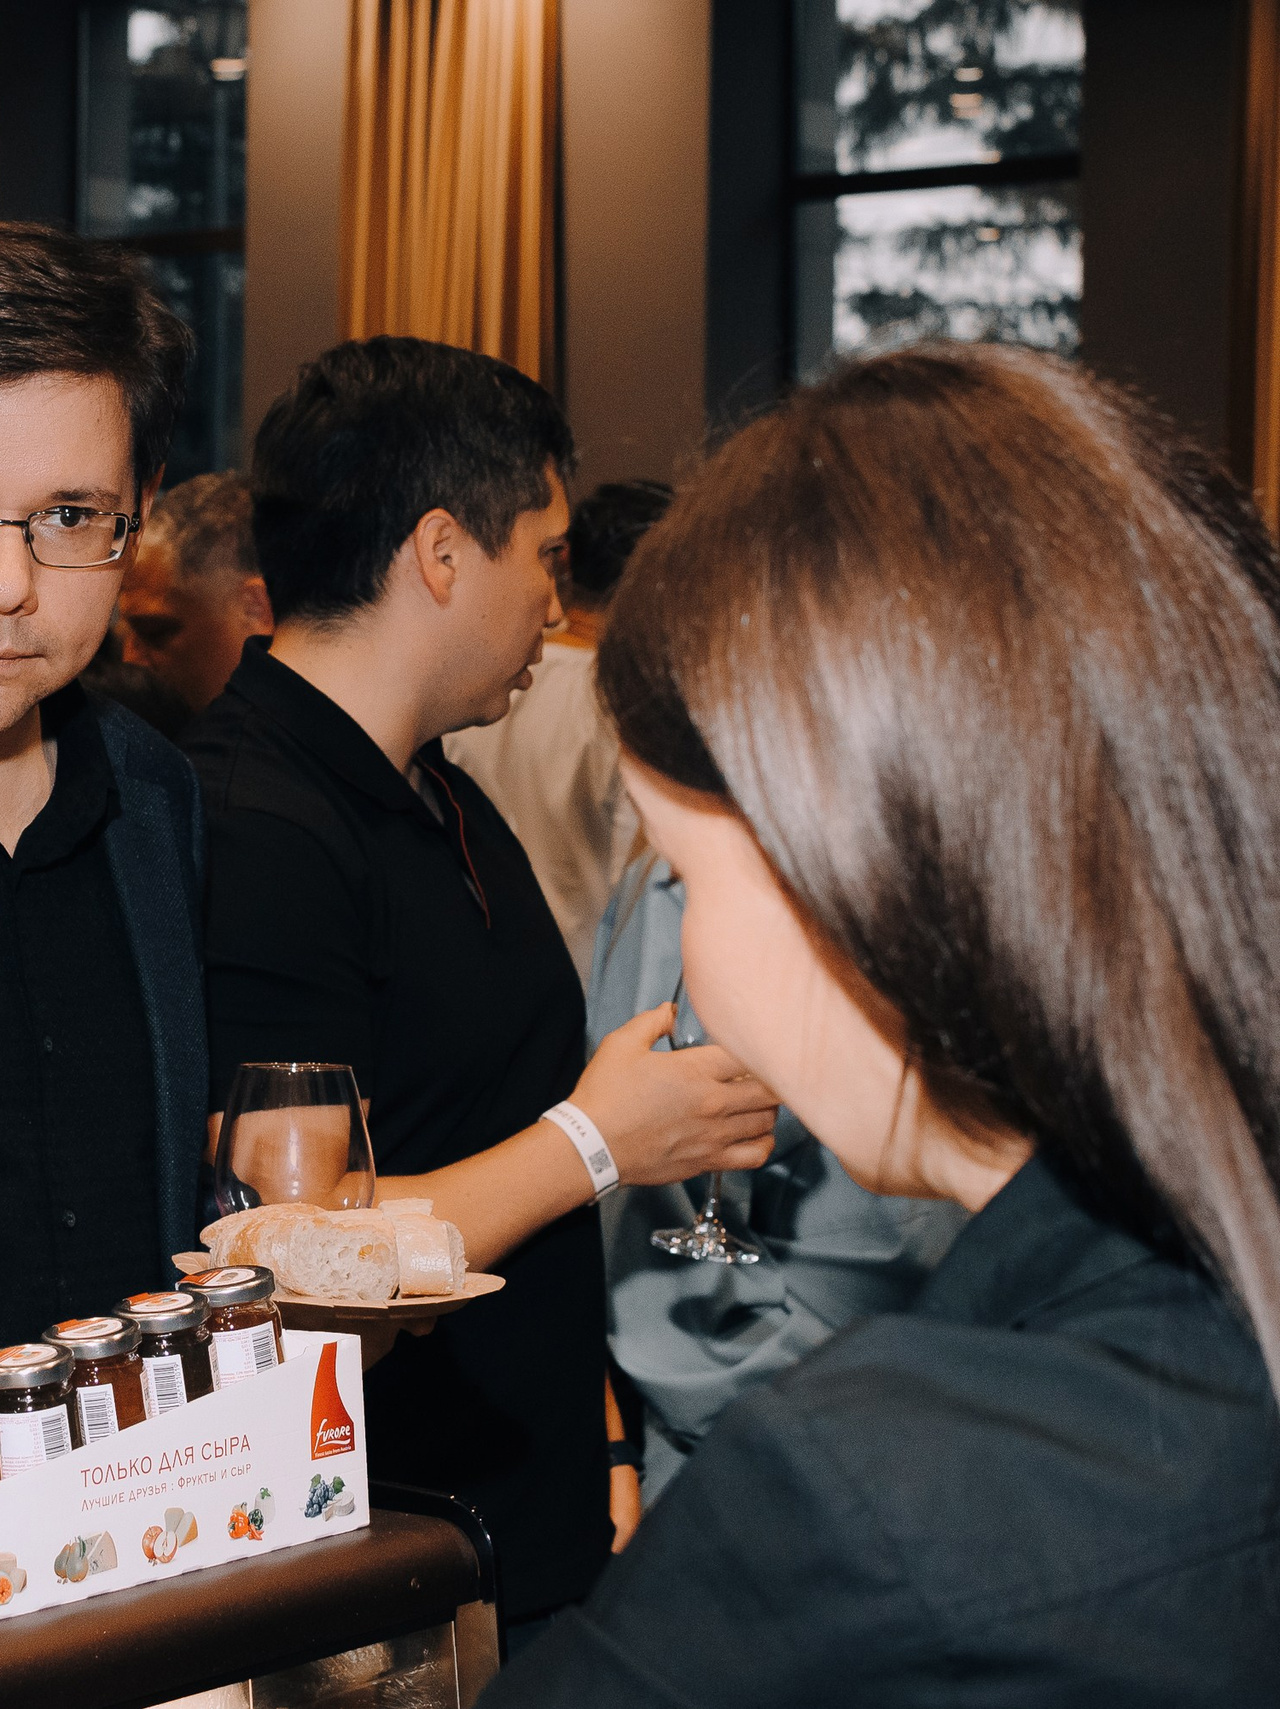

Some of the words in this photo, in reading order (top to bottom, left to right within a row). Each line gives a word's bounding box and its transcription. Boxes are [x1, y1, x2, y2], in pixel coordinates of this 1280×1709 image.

[81, 1456, 152, 1488] ТОЛЬКО
[158, 1446, 195, 1474] ДЛЯ
[201, 1434, 251, 1461] СЫРА
[81, 1492, 125, 1512] ЛУЧШИЕ
[128, 1482, 167, 1502] ДРУЗЬЯ
[177, 1471, 217, 1489] ФРУКТЫ
[220, 1468, 228, 1480] И
[230, 1463, 252, 1477] СЫР
